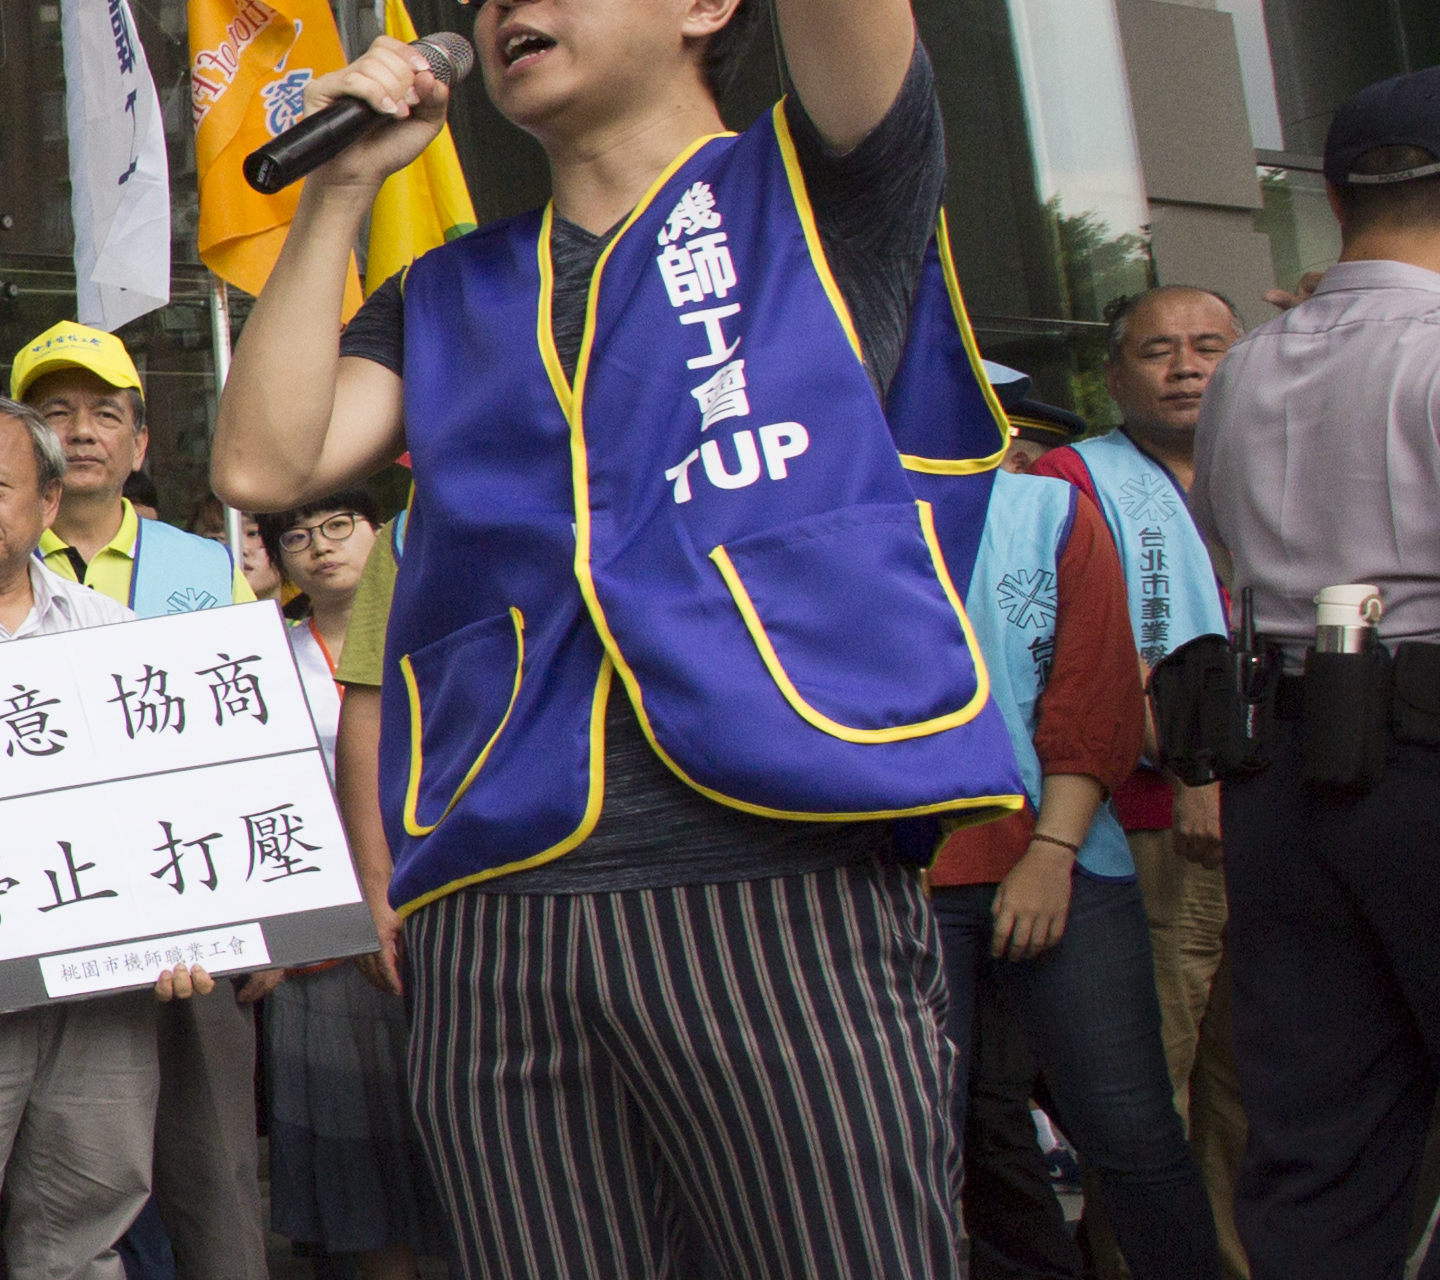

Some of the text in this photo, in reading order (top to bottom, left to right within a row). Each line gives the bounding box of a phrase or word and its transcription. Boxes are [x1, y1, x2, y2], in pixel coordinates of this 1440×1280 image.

[657, 181, 750, 432] 機師工會
[665, 421, 810, 504] TUP
